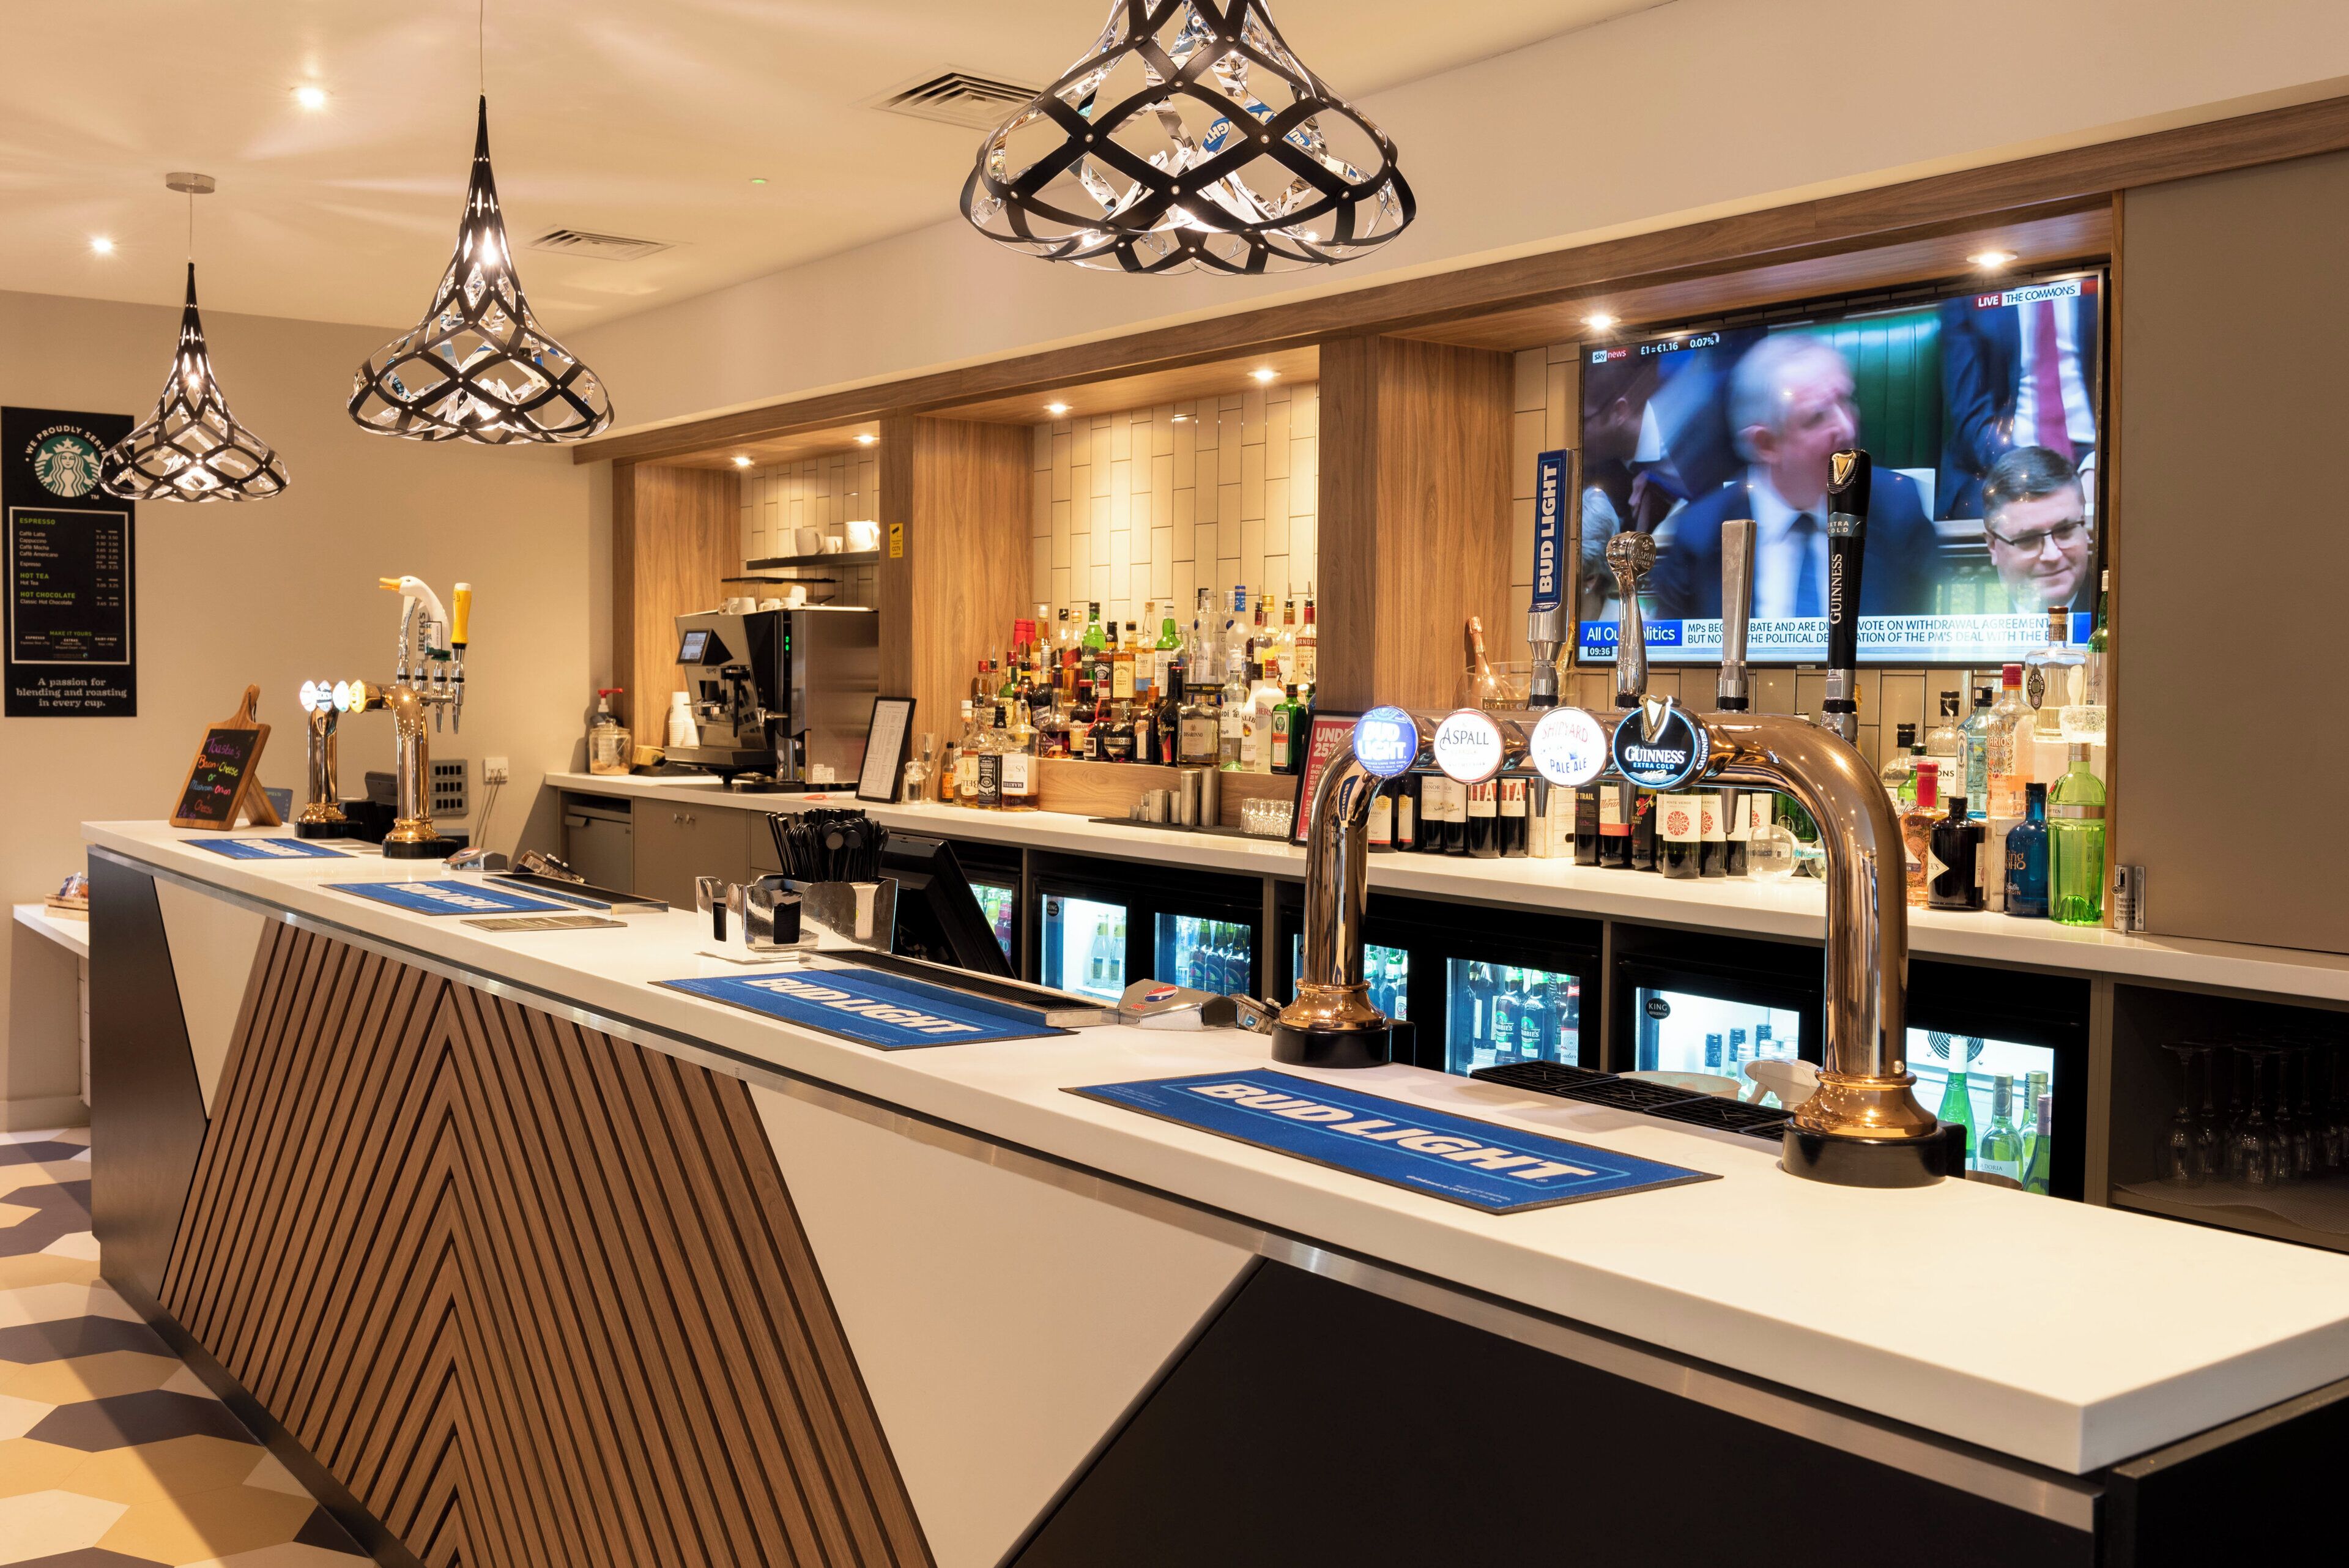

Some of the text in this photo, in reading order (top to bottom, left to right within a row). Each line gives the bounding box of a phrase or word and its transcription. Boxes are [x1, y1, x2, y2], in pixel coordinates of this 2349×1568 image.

[1978, 285, 2075, 307] LIVE THE COMMONS
[1595, 349, 1626, 361] sky news
[25, 440, 37, 454] WE
[37, 425, 82, 440] PROUDLY
[1538, 465, 1557, 593] BUD LIGHT
[1830, 554, 1842, 624] GUINNESS
[1586, 626, 1601, 641] All
[1604, 628, 1619, 641] Ou
[1688, 623, 1706, 633] MPs
[1775, 622, 1795, 632] AND
[1798, 622, 1816, 631] ARE
[1819, 622, 1830, 631] DU
[1858, 620, 1884, 630] VOTE
[1887, 620, 1903, 630] ON
[1906, 619, 1979, 630] WITHDRAWAL
[1688, 634, 1705, 644] BUT
[1765, 633, 1814, 643] POLITICAL
[1888, 633, 1902, 642] OF
[1904, 632, 1924, 641] THE
[1928, 631, 1953, 642] PM'S
[1956, 631, 1984, 641] DEAL
[1987, 631, 2016, 641] WITH
[2019, 630, 2042, 641] THE
[1589, 647, 1611, 656] 09:36
[49, 678, 87, 687] passion
[2035, 674, 2044, 689] HITCH
[16, 688, 61, 697] blending
[86, 688, 127, 698] roasting
[53, 699, 81, 708] every
[84, 700, 106, 708] cup.
[1363, 721, 1400, 742] BUD
[1439, 727, 1489, 750] ASPALL
[1542, 721, 1589, 743] SHIPYARD
[1696, 728, 1710, 770] GUINNESS
[1989, 736, 2013, 747] ARIOS
[1625, 746, 1686, 764] GUINNESS
[198, 754, 239, 776] Bacon Cheese
[1550, 757, 1587, 773] PALE ALE
[741, 978, 984, 1034] BUD LIGHT
[1187, 1083, 1354, 1122] BUD
[1326, 1119, 1597, 1180] LIGHT
